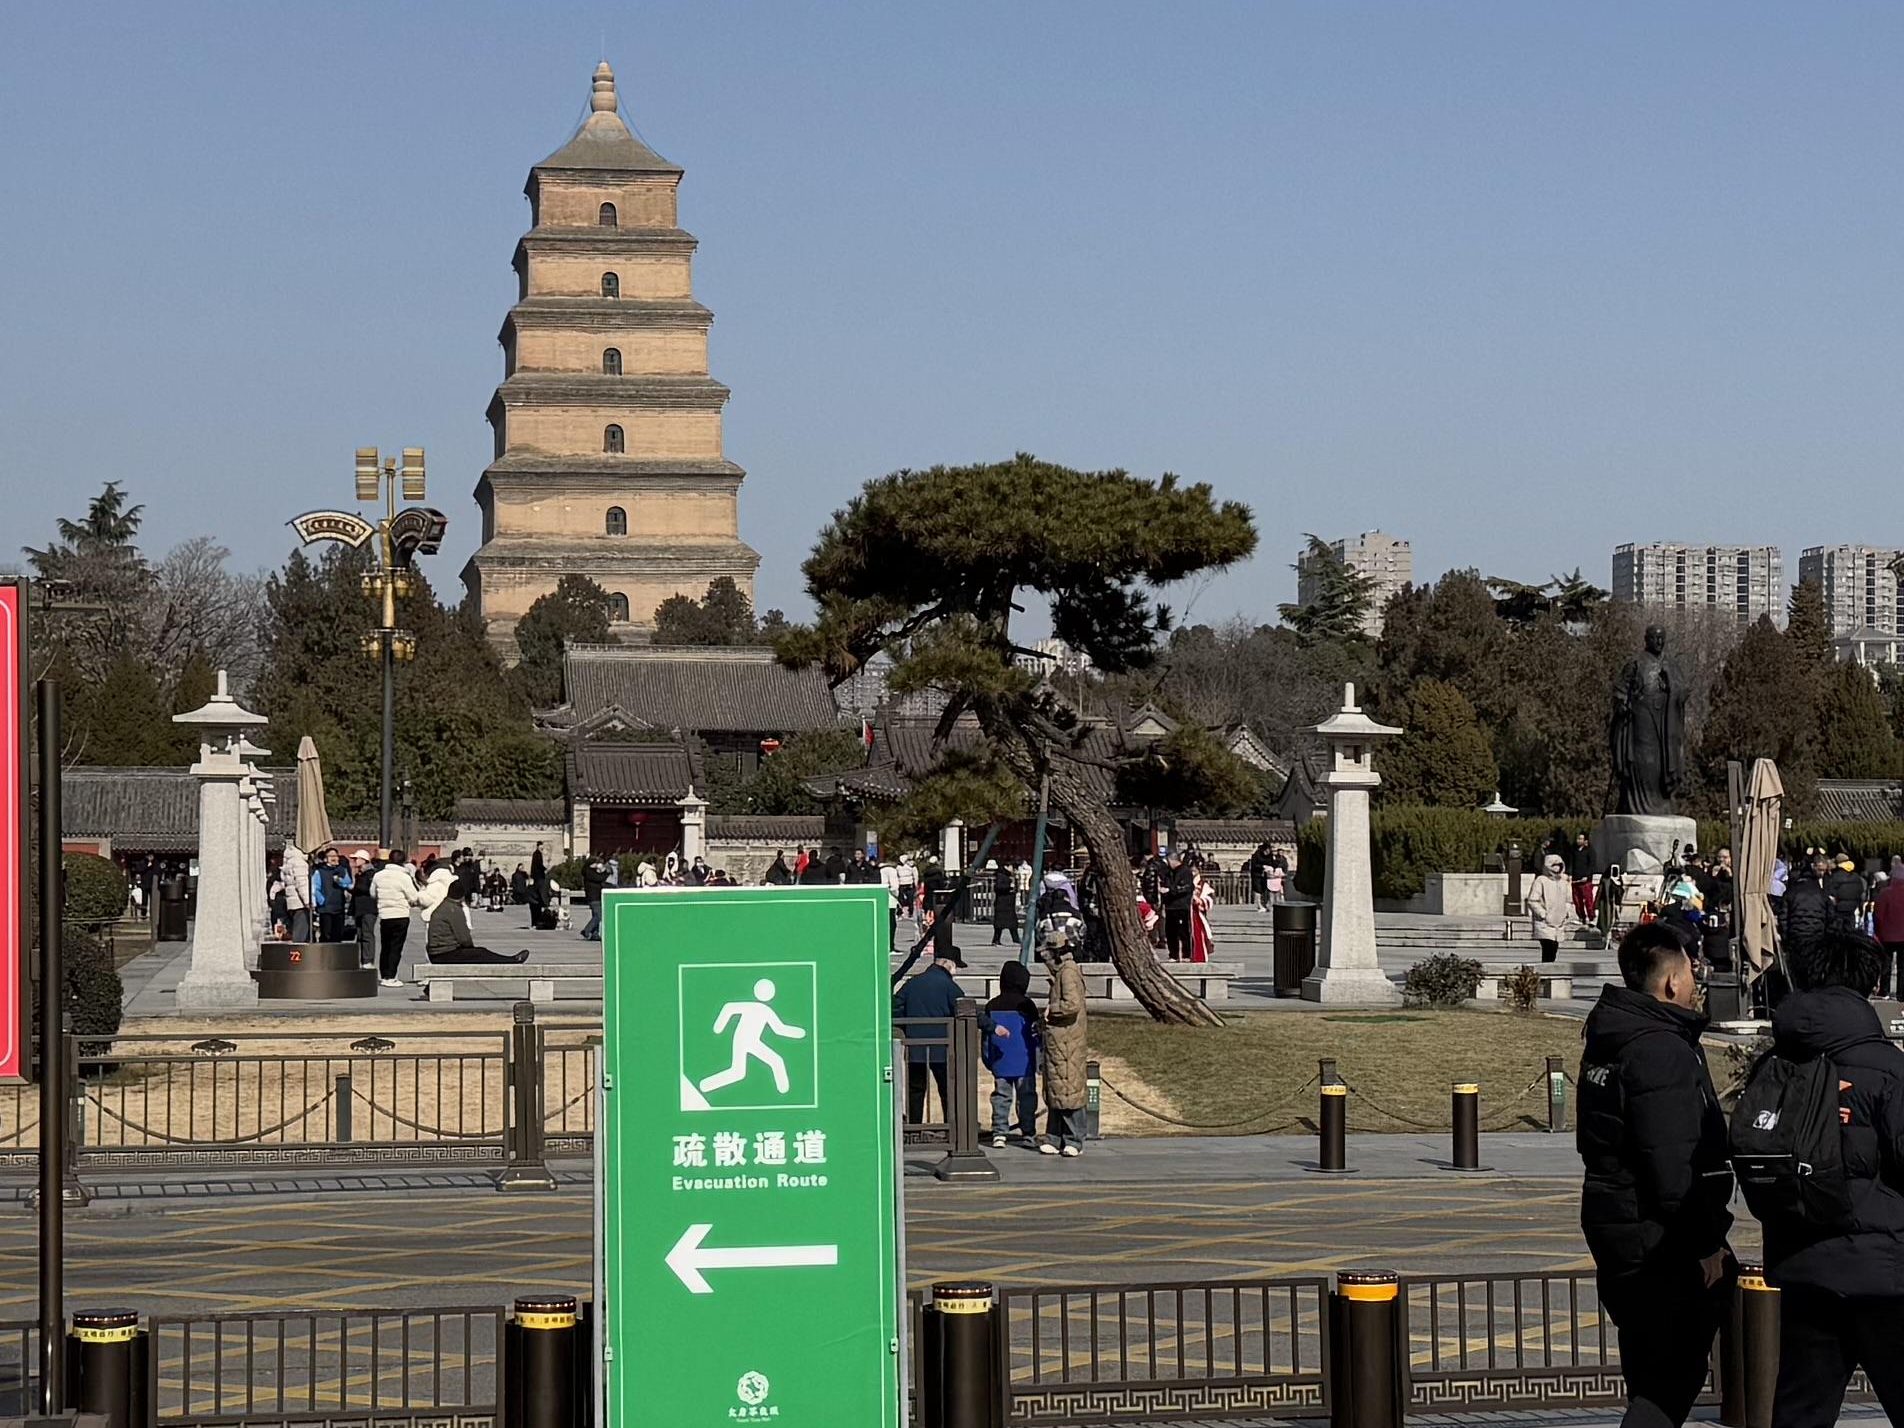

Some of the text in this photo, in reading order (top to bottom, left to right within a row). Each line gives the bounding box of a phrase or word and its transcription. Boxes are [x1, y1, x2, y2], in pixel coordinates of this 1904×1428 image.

[672, 1130, 827, 1167] 疏散通道
[672, 1173, 828, 1190] Evacuation Route
